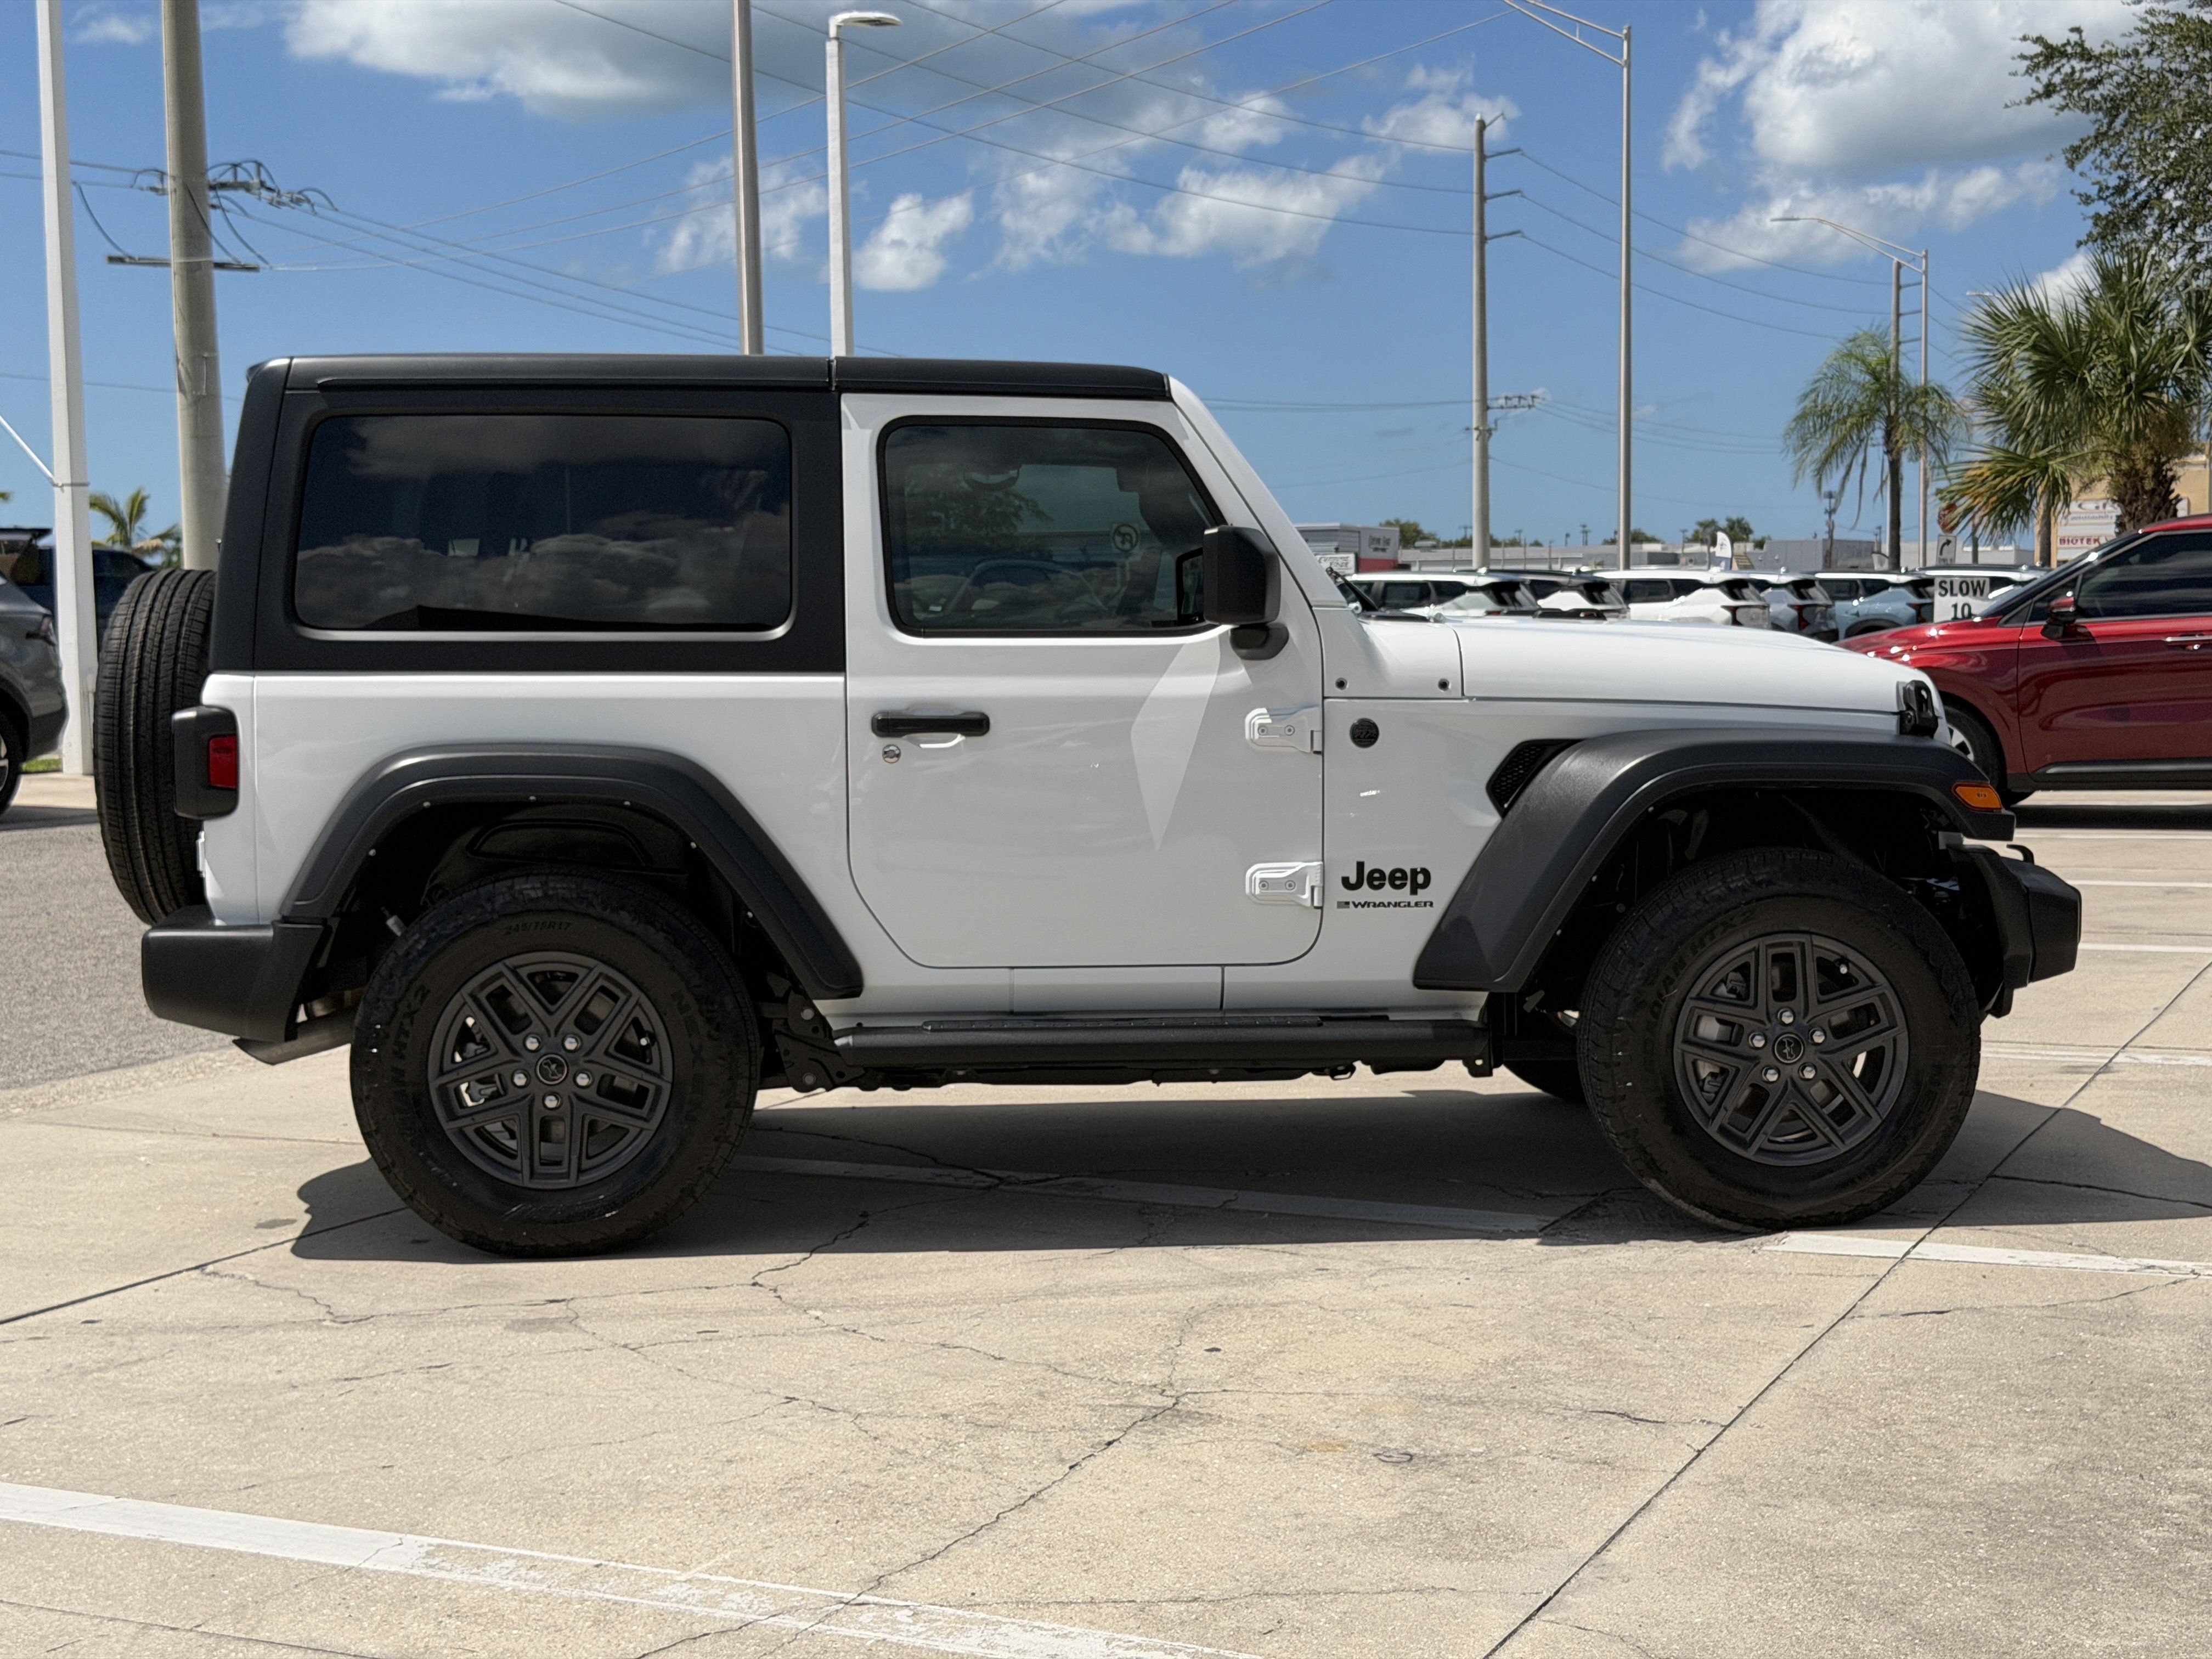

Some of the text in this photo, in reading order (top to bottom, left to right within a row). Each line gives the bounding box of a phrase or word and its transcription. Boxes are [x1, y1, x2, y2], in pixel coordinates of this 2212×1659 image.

[1938, 579, 1986, 597] SLOW
[1951, 602, 1972, 620] 10
[1341, 861, 1431, 895] Jeep
